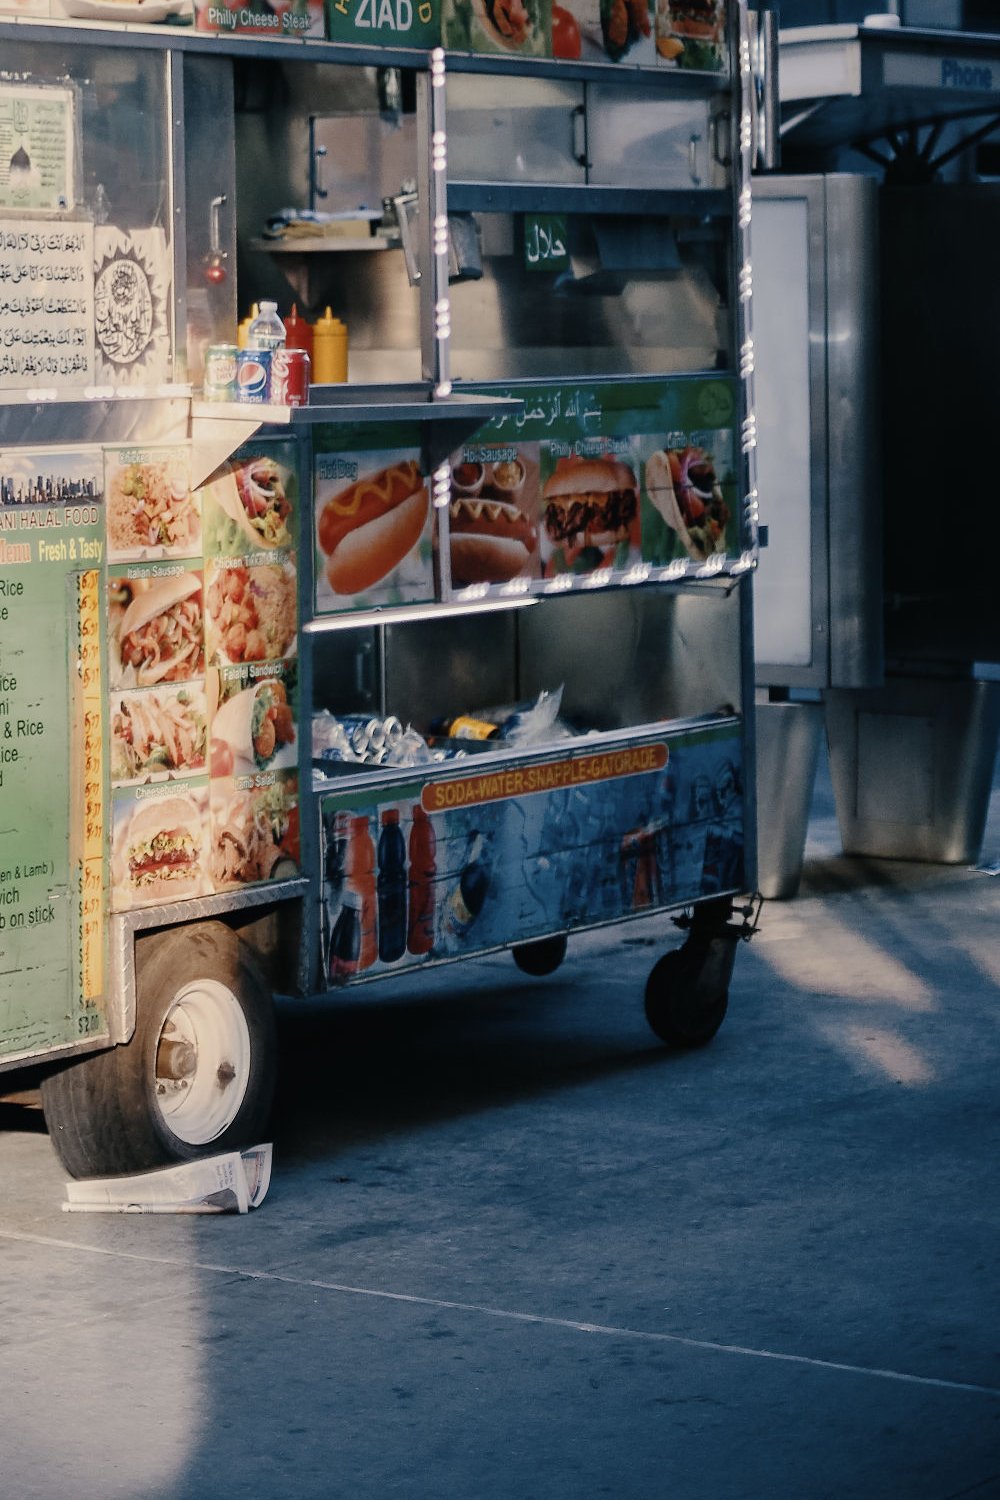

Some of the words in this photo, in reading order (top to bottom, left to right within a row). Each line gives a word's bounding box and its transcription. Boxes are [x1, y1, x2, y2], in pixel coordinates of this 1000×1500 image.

[208, 7, 237, 29] Philly
[240, 10, 279, 28] Cheese
[282, 11, 312, 29] Steak
[941, 59, 993, 89] Phone
[527, 223, 566, 262] حلال
[480, 447, 518, 462] Sausage
[20, 510, 62, 529] HALAL
[64, 507, 99, 526] FOOD
[38, 540, 67, 562] Fresh
[68, 538, 77, 559] &
[78, 537, 103, 563] Tasty
[127, 567, 150, 579] Italian
[152, 564, 185, 578] Sausage
[213, 556, 243, 570] Chicken
[223, 666, 248, 681] Falafel
[249, 664, 284, 678] Sandwich
[4, 723, 13, 739] &
[16, 720, 44, 738] Rice
[135, 781, 189, 800] Cheeseburger
[14, 867, 21, 881] &
[23, 862, 48, 879] Lamb
[9, 911, 24, 928] on
[28, 904, 55, 924] stick
